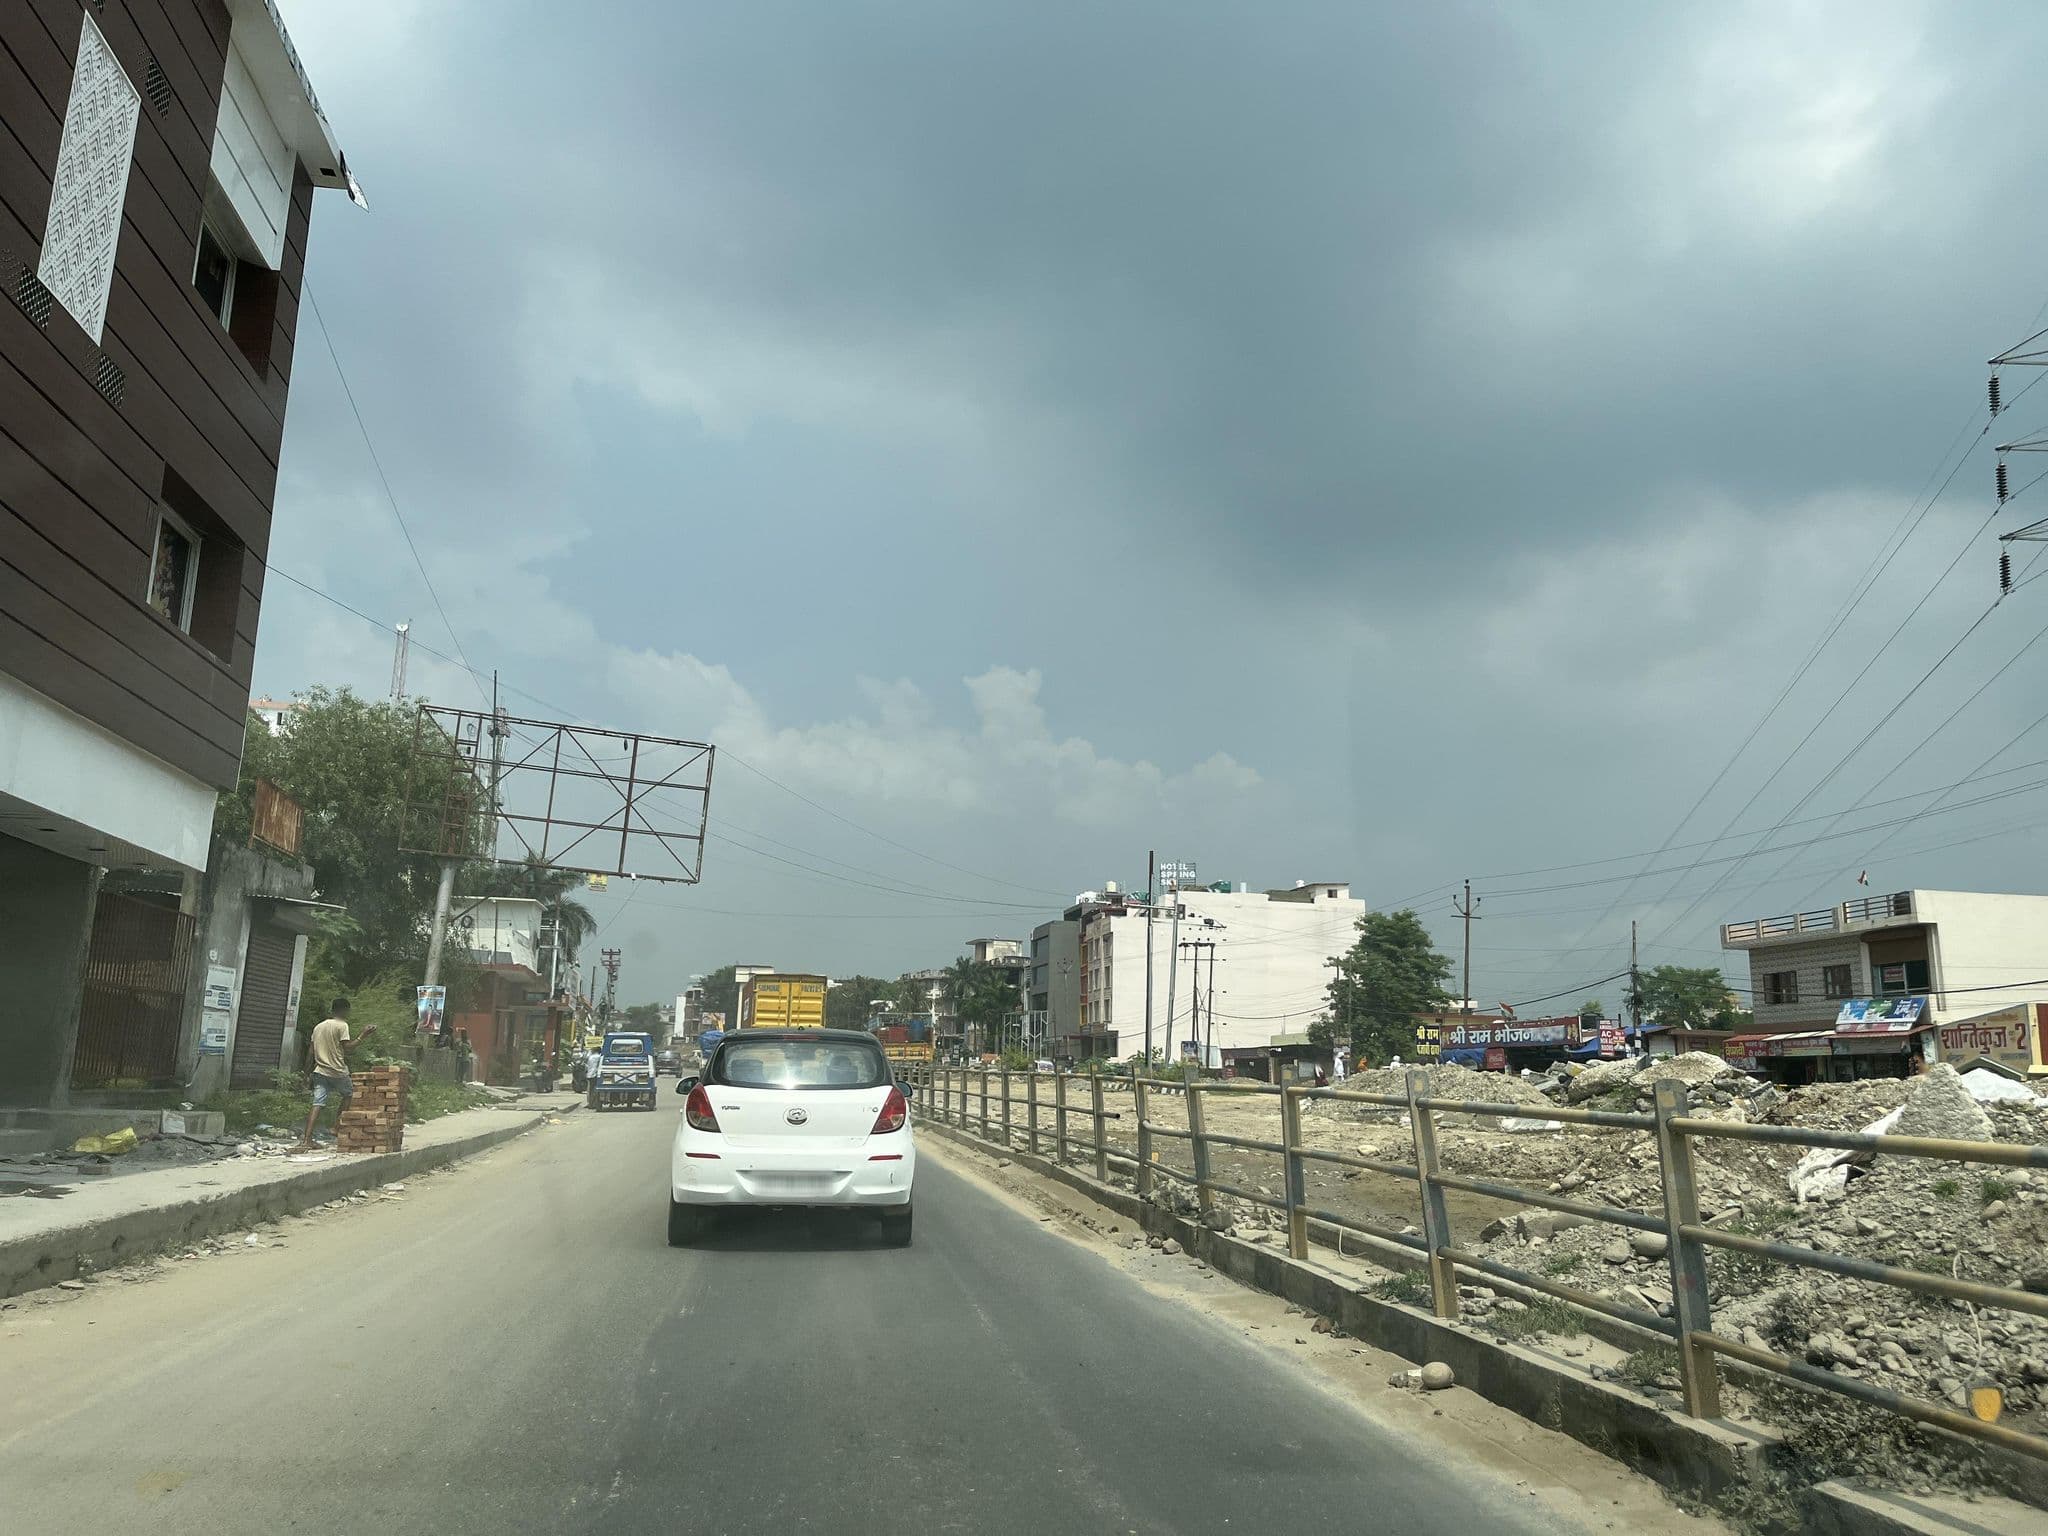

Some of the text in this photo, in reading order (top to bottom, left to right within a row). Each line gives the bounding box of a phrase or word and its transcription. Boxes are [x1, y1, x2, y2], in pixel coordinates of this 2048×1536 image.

[1450, 1026, 1466, 1044] श्री
[1469, 1029, 1491, 1044] राम
[1601, 1030, 1612, 1038] AC
